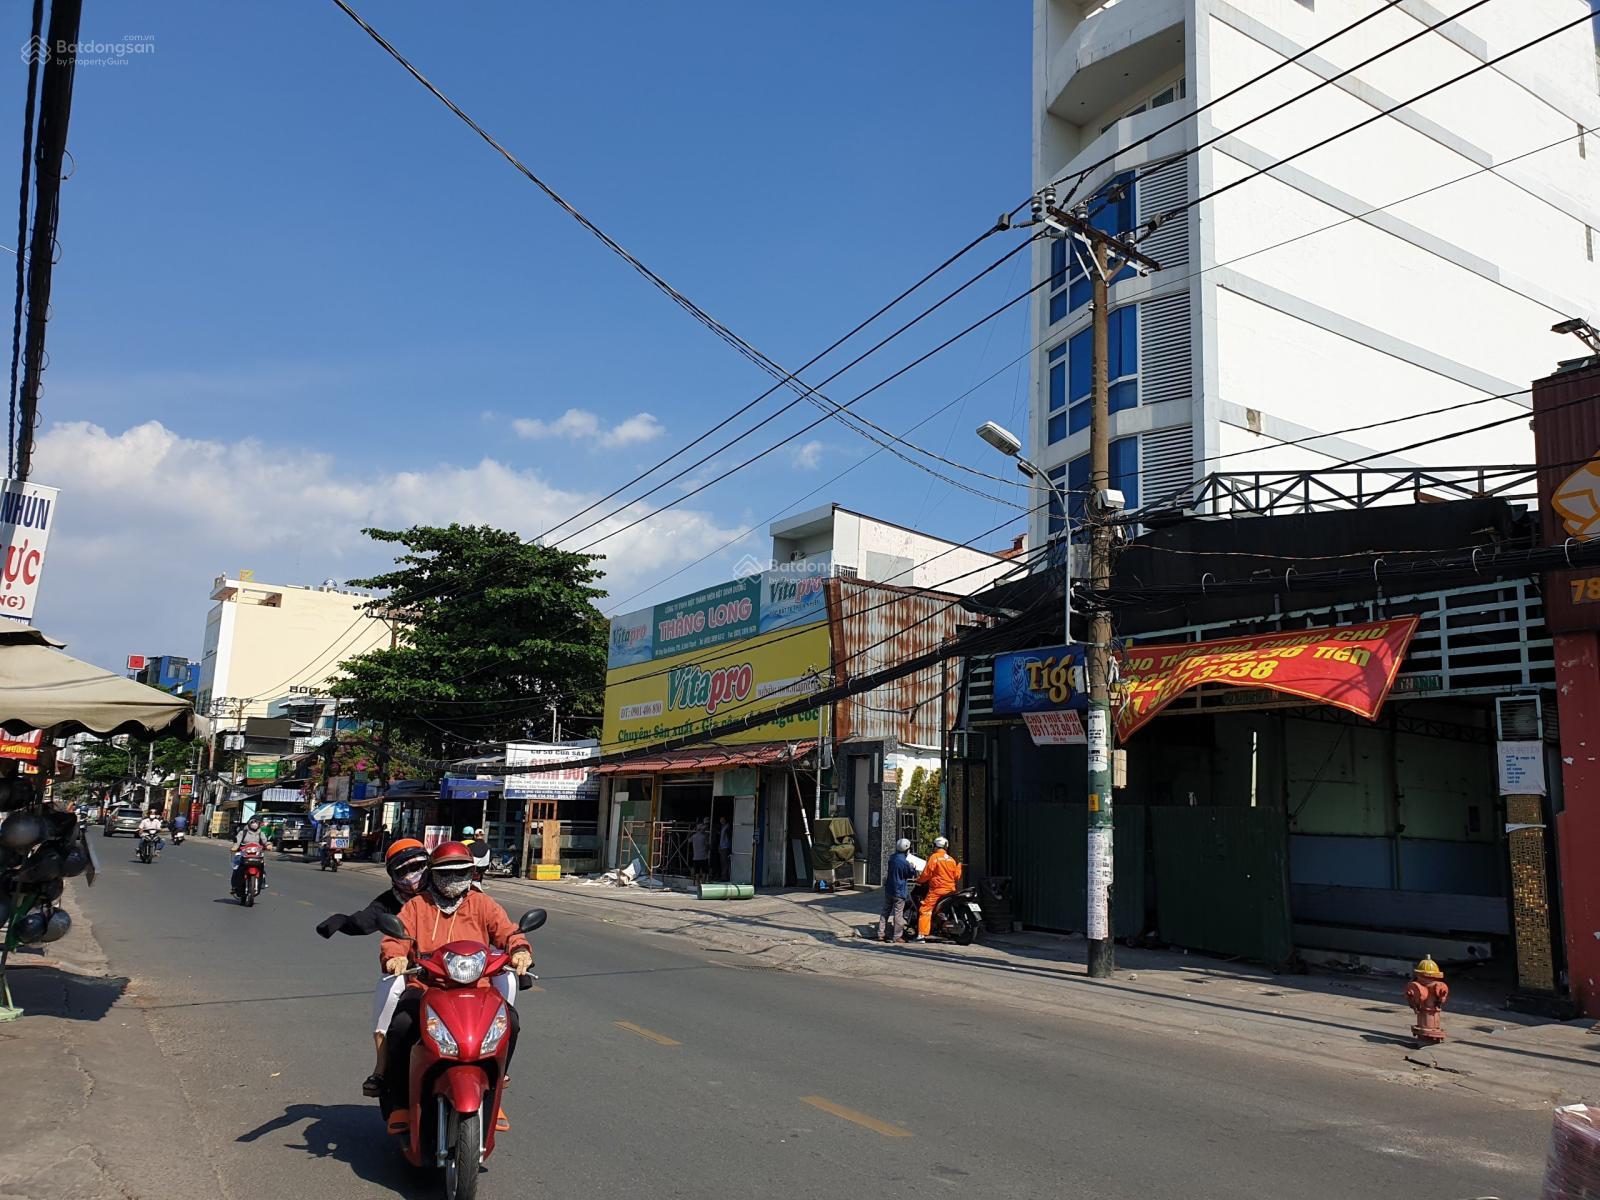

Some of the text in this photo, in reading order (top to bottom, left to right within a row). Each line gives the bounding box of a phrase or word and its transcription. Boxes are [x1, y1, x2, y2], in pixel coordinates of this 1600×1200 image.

[1, 490, 51, 530] NHÚN
[708, 596, 753, 629] LONG
[668, 662, 753, 714] Vitapro
